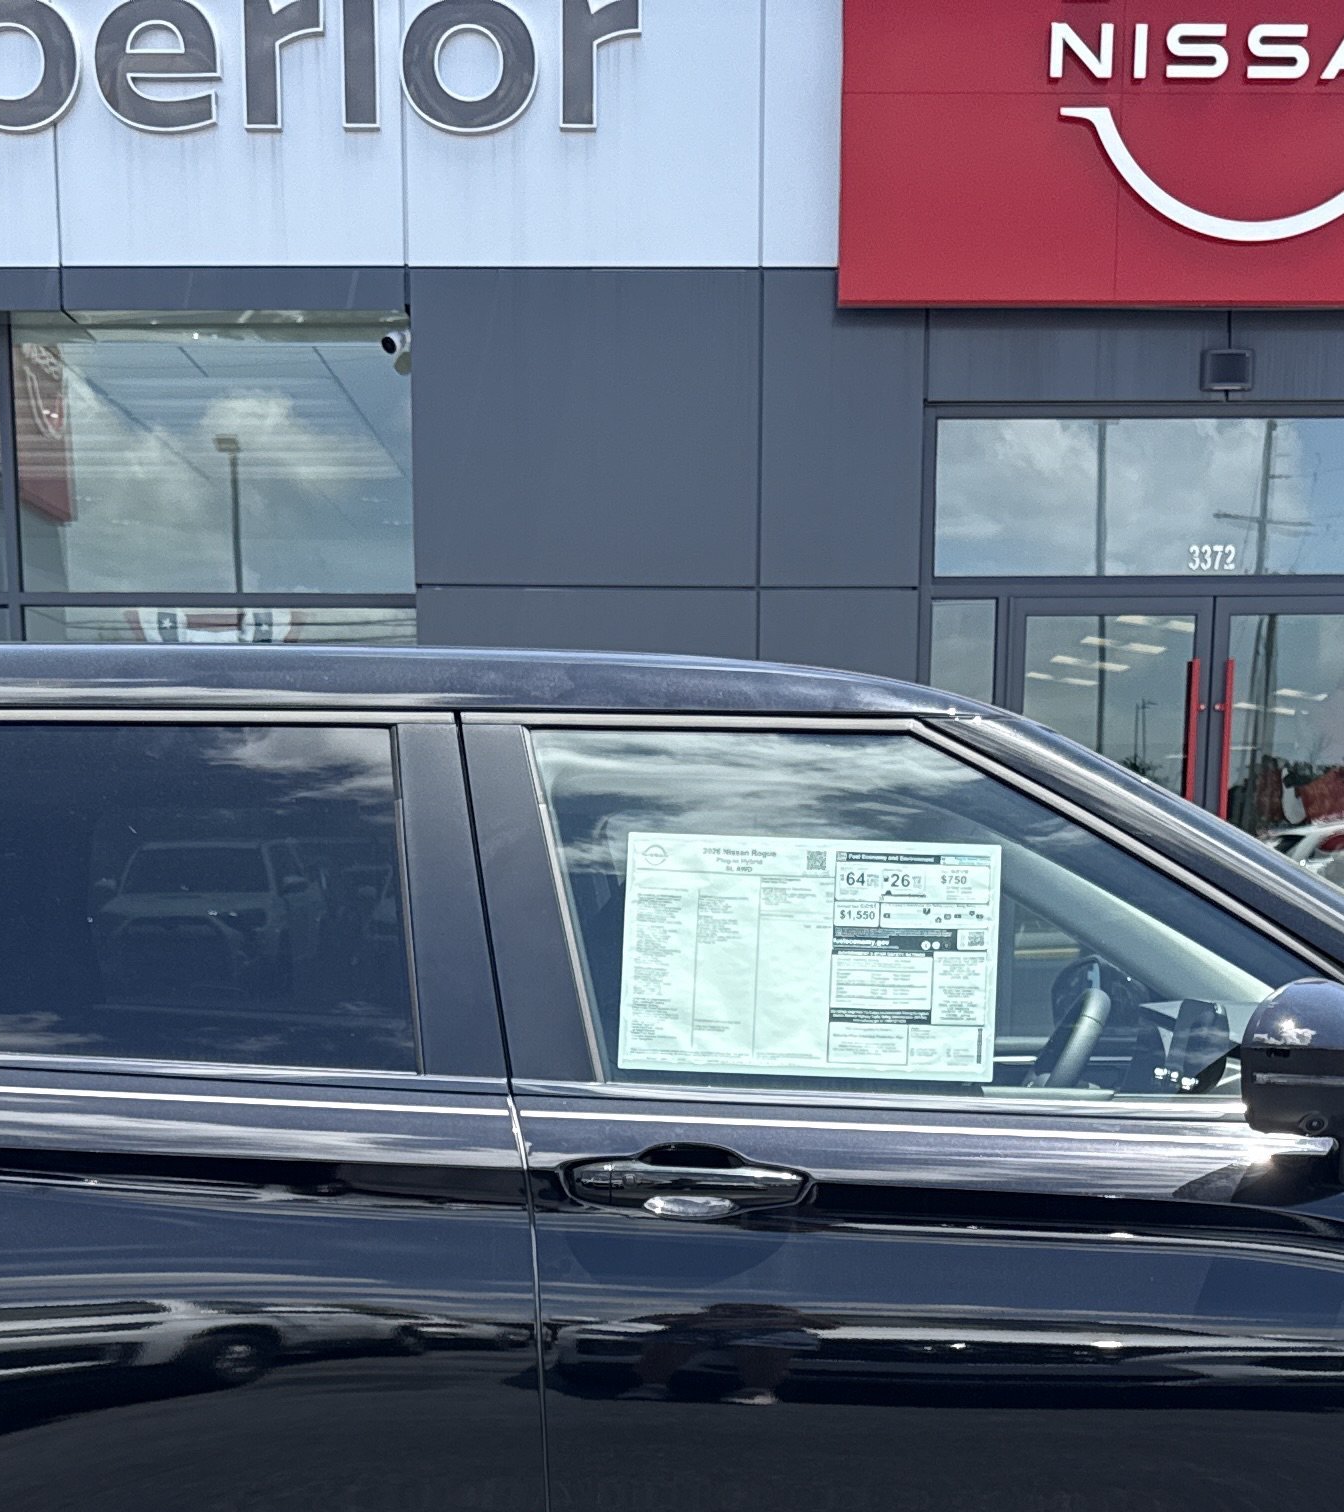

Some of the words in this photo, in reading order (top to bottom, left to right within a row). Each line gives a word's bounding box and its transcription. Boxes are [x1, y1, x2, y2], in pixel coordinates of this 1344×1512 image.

[1188, 544, 1236, 571] 3372
[846, 871, 866, 886] 64
[890, 873, 911, 888] 26
[940, 874, 967, 885] $750
[839, 909, 876, 920] $1,550
